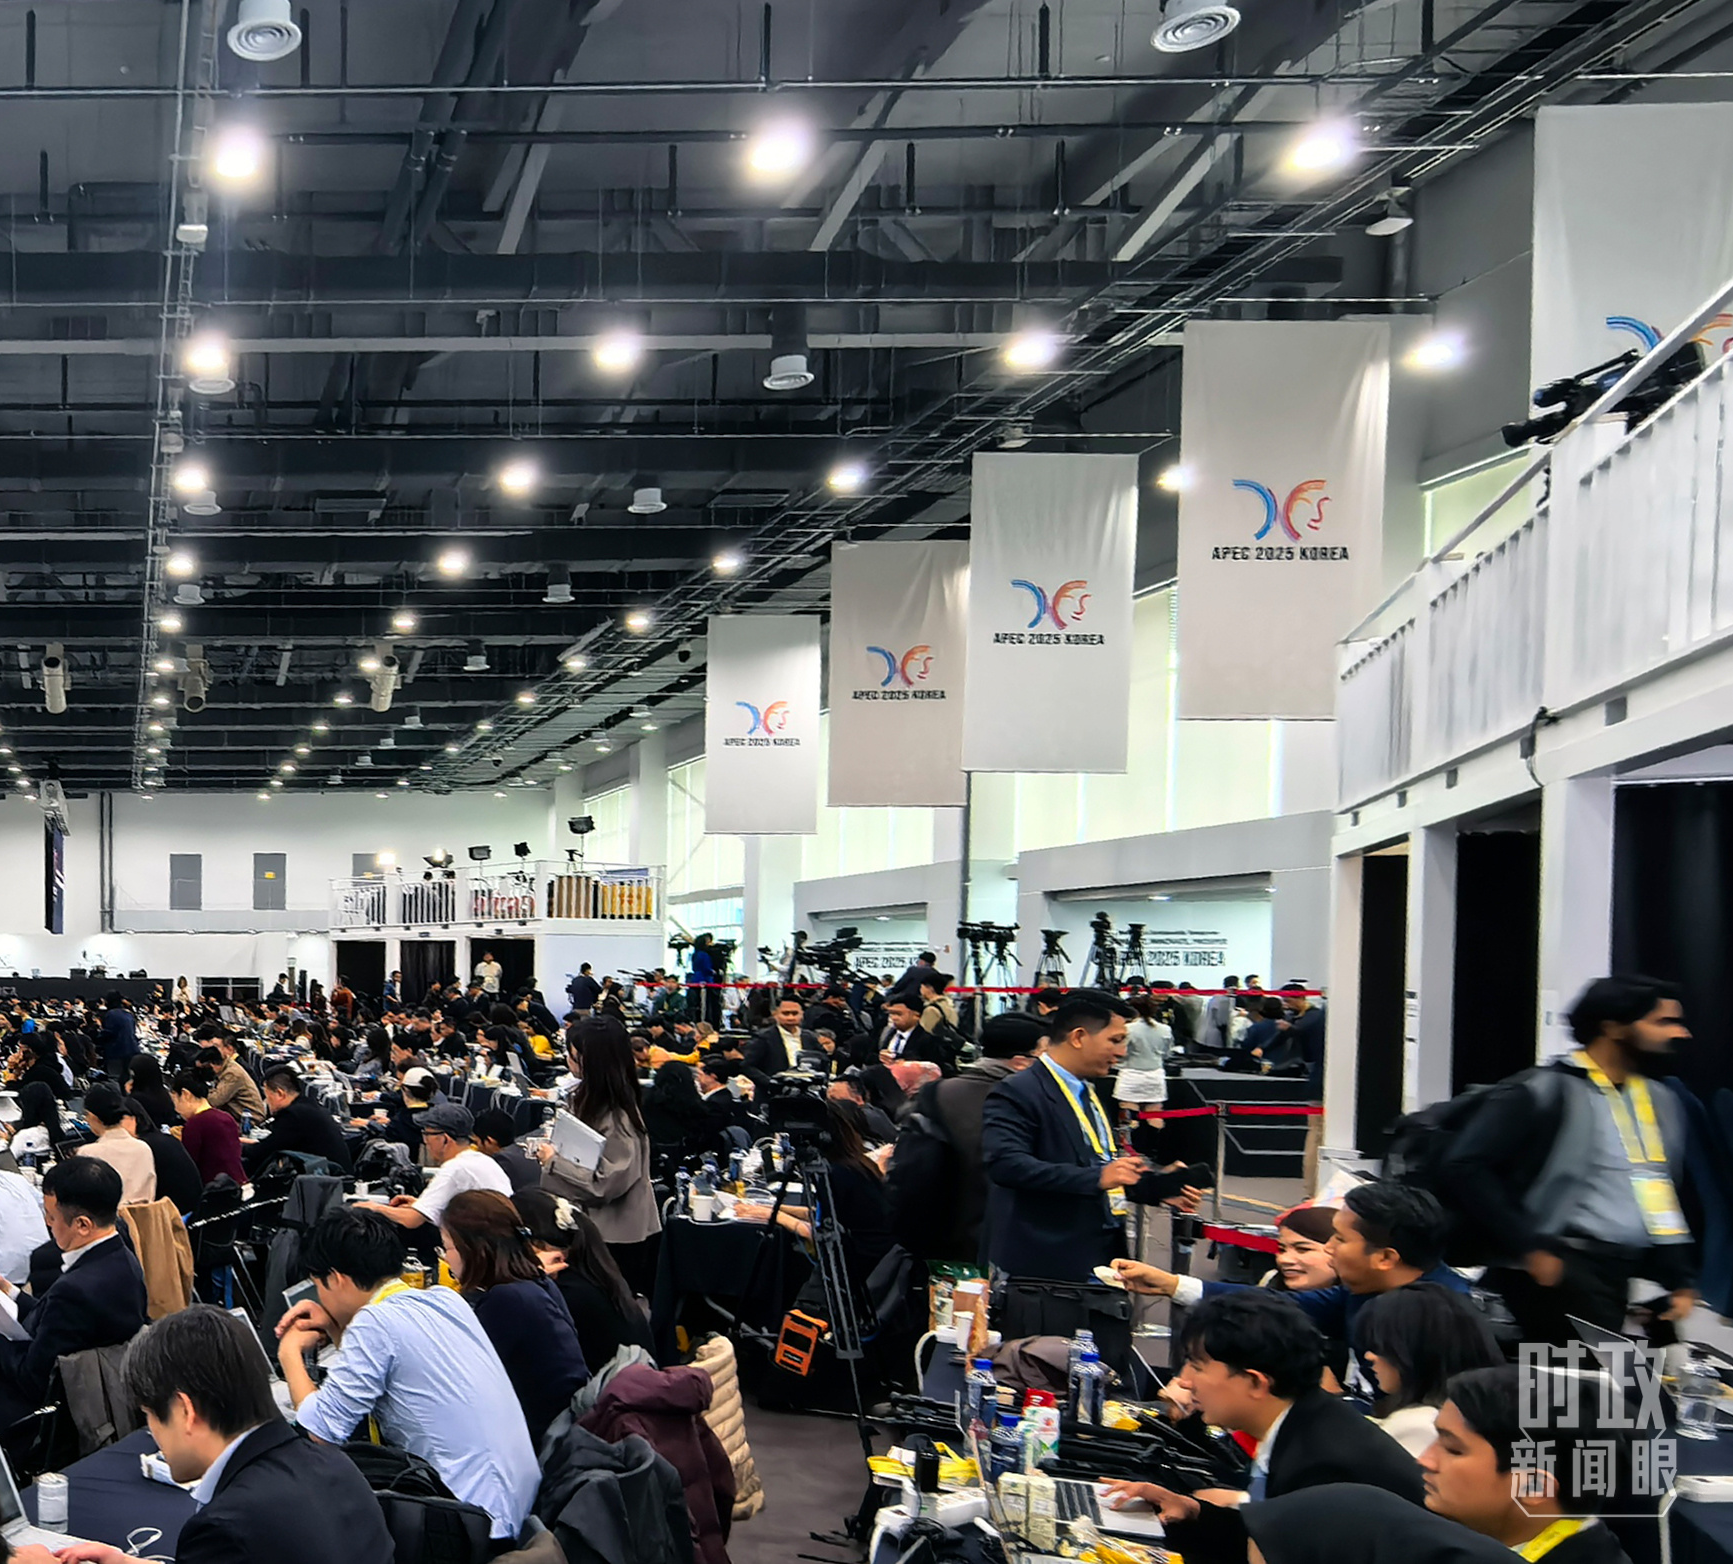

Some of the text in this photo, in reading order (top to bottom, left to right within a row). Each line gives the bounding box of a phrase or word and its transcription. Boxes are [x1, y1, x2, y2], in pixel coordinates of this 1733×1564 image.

[1212, 546, 1349, 561] APEC 2025 KOREA
[993, 633, 1105, 645] APEC 2025 KOREA
[881, 690, 909, 700] 2025
[1146, 950, 1180, 966] 2025
[1183, 950, 1225, 966] KOREA
